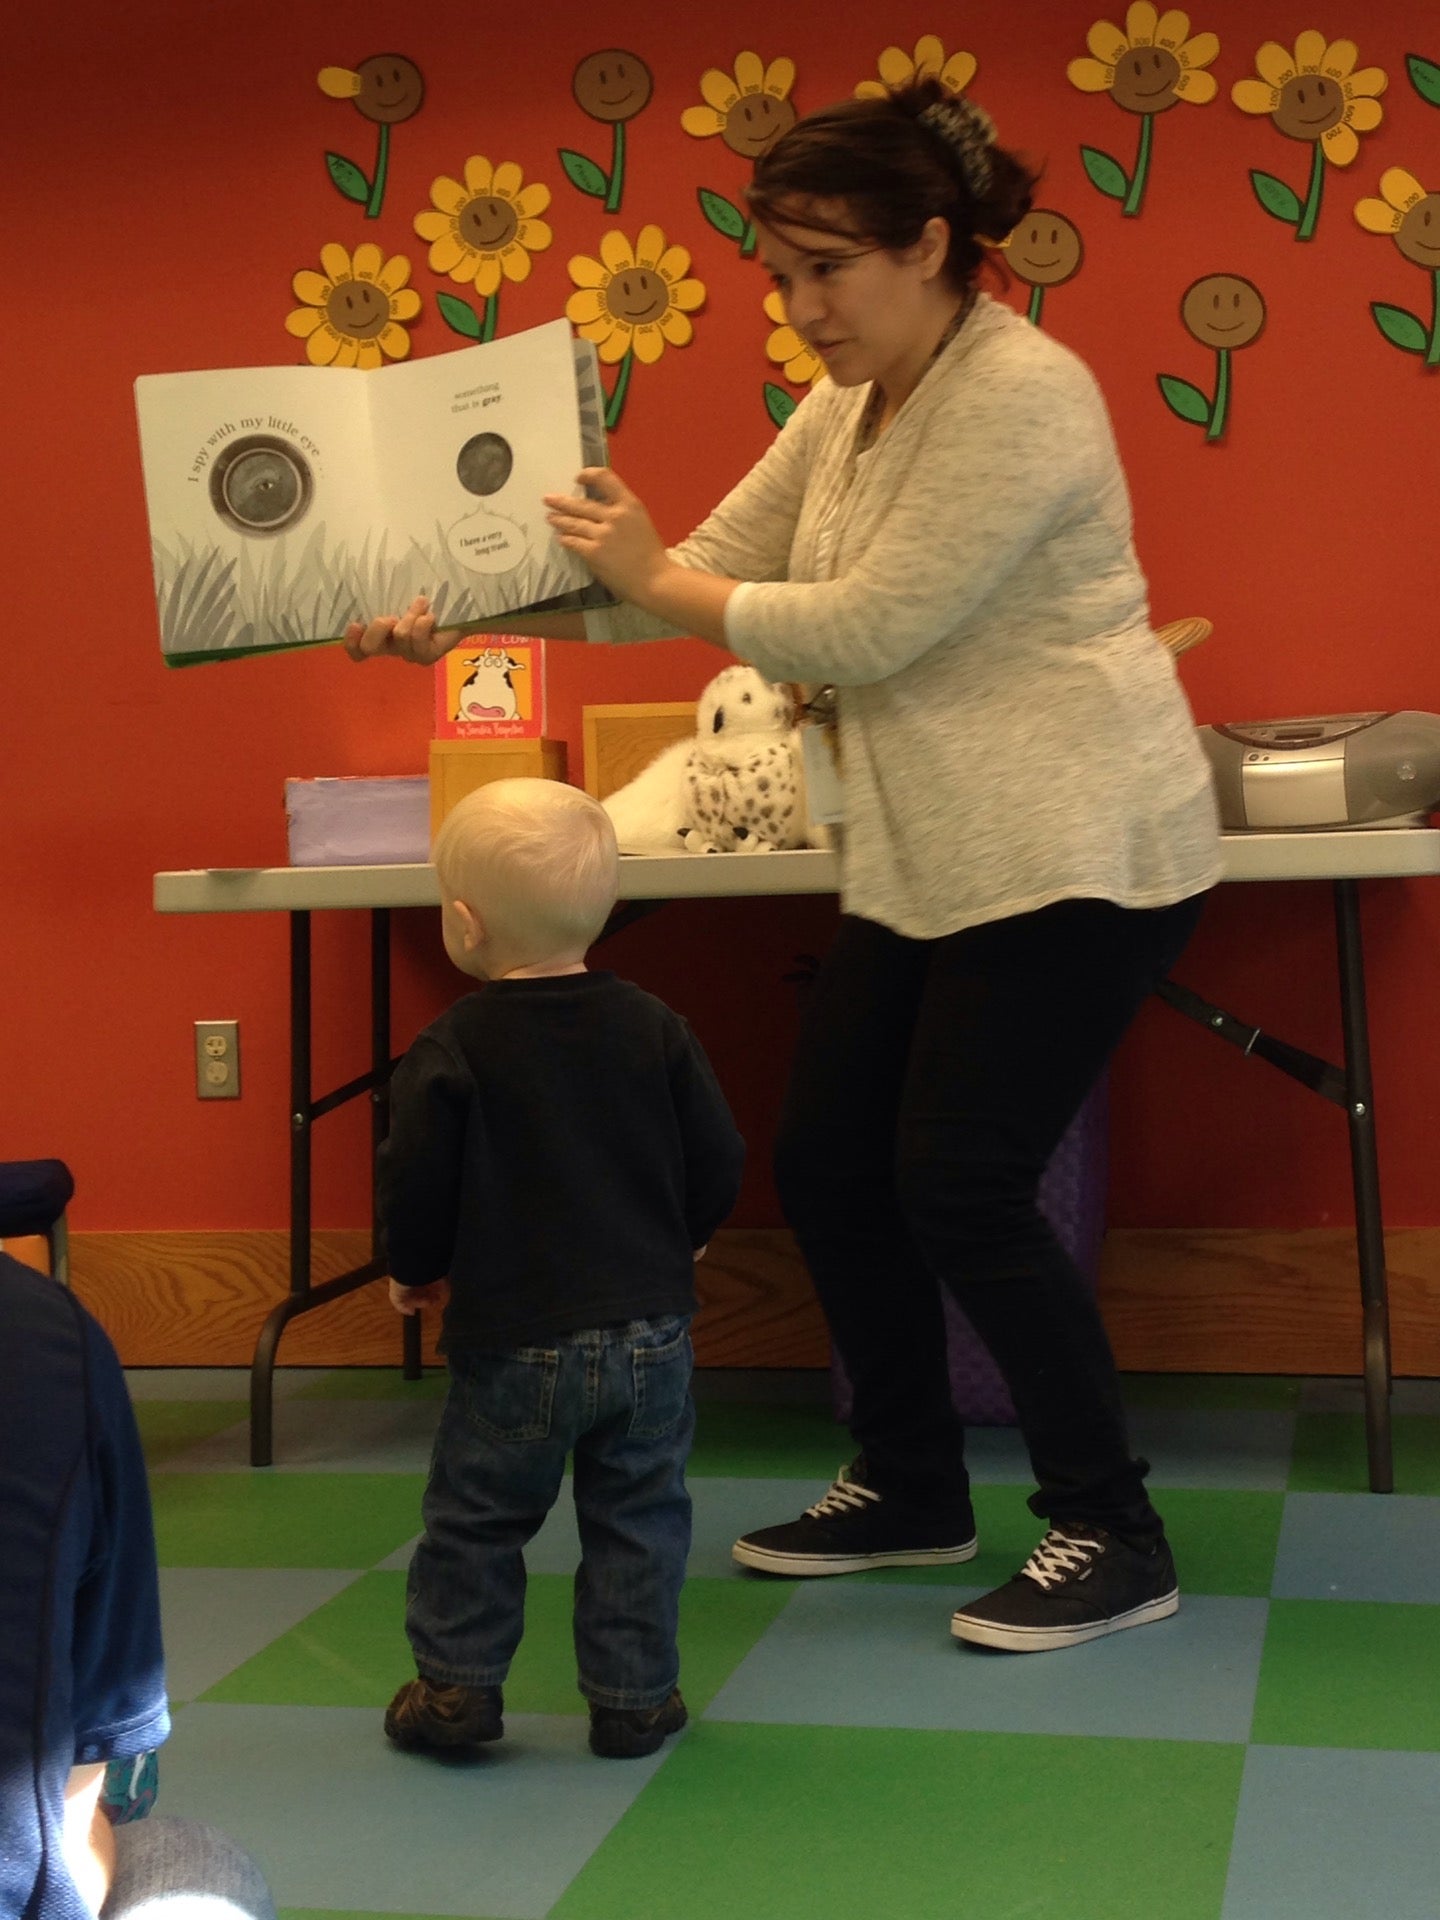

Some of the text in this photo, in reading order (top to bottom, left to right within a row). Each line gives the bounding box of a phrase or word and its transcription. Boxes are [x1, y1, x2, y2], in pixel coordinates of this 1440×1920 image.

[1111, 45, 1125, 60] 200
[1178, 51, 1190, 67] 500
[1104, 67, 1113, 84] 100
[1278, 70, 1293, 84] 200
[1302, 65, 1318, 74] 300
[1326, 67, 1342, 79] 400
[1178, 75, 1190, 91] 600
[1344, 82, 1354, 100] 500
[1270, 90, 1279, 107] 100
[1343, 105, 1355, 122] 600
[1325, 127, 1341, 140] 700
[1403, 192, 1420, 208] 200
[1391, 212, 1402, 229] 100
[451, 402, 469, 413] that
[471, 400, 479, 408] is
[192, 447, 210, 474] spy
[206, 422, 236, 447] with
[240, 417, 263, 430] my
[268, 416, 299, 437] little
